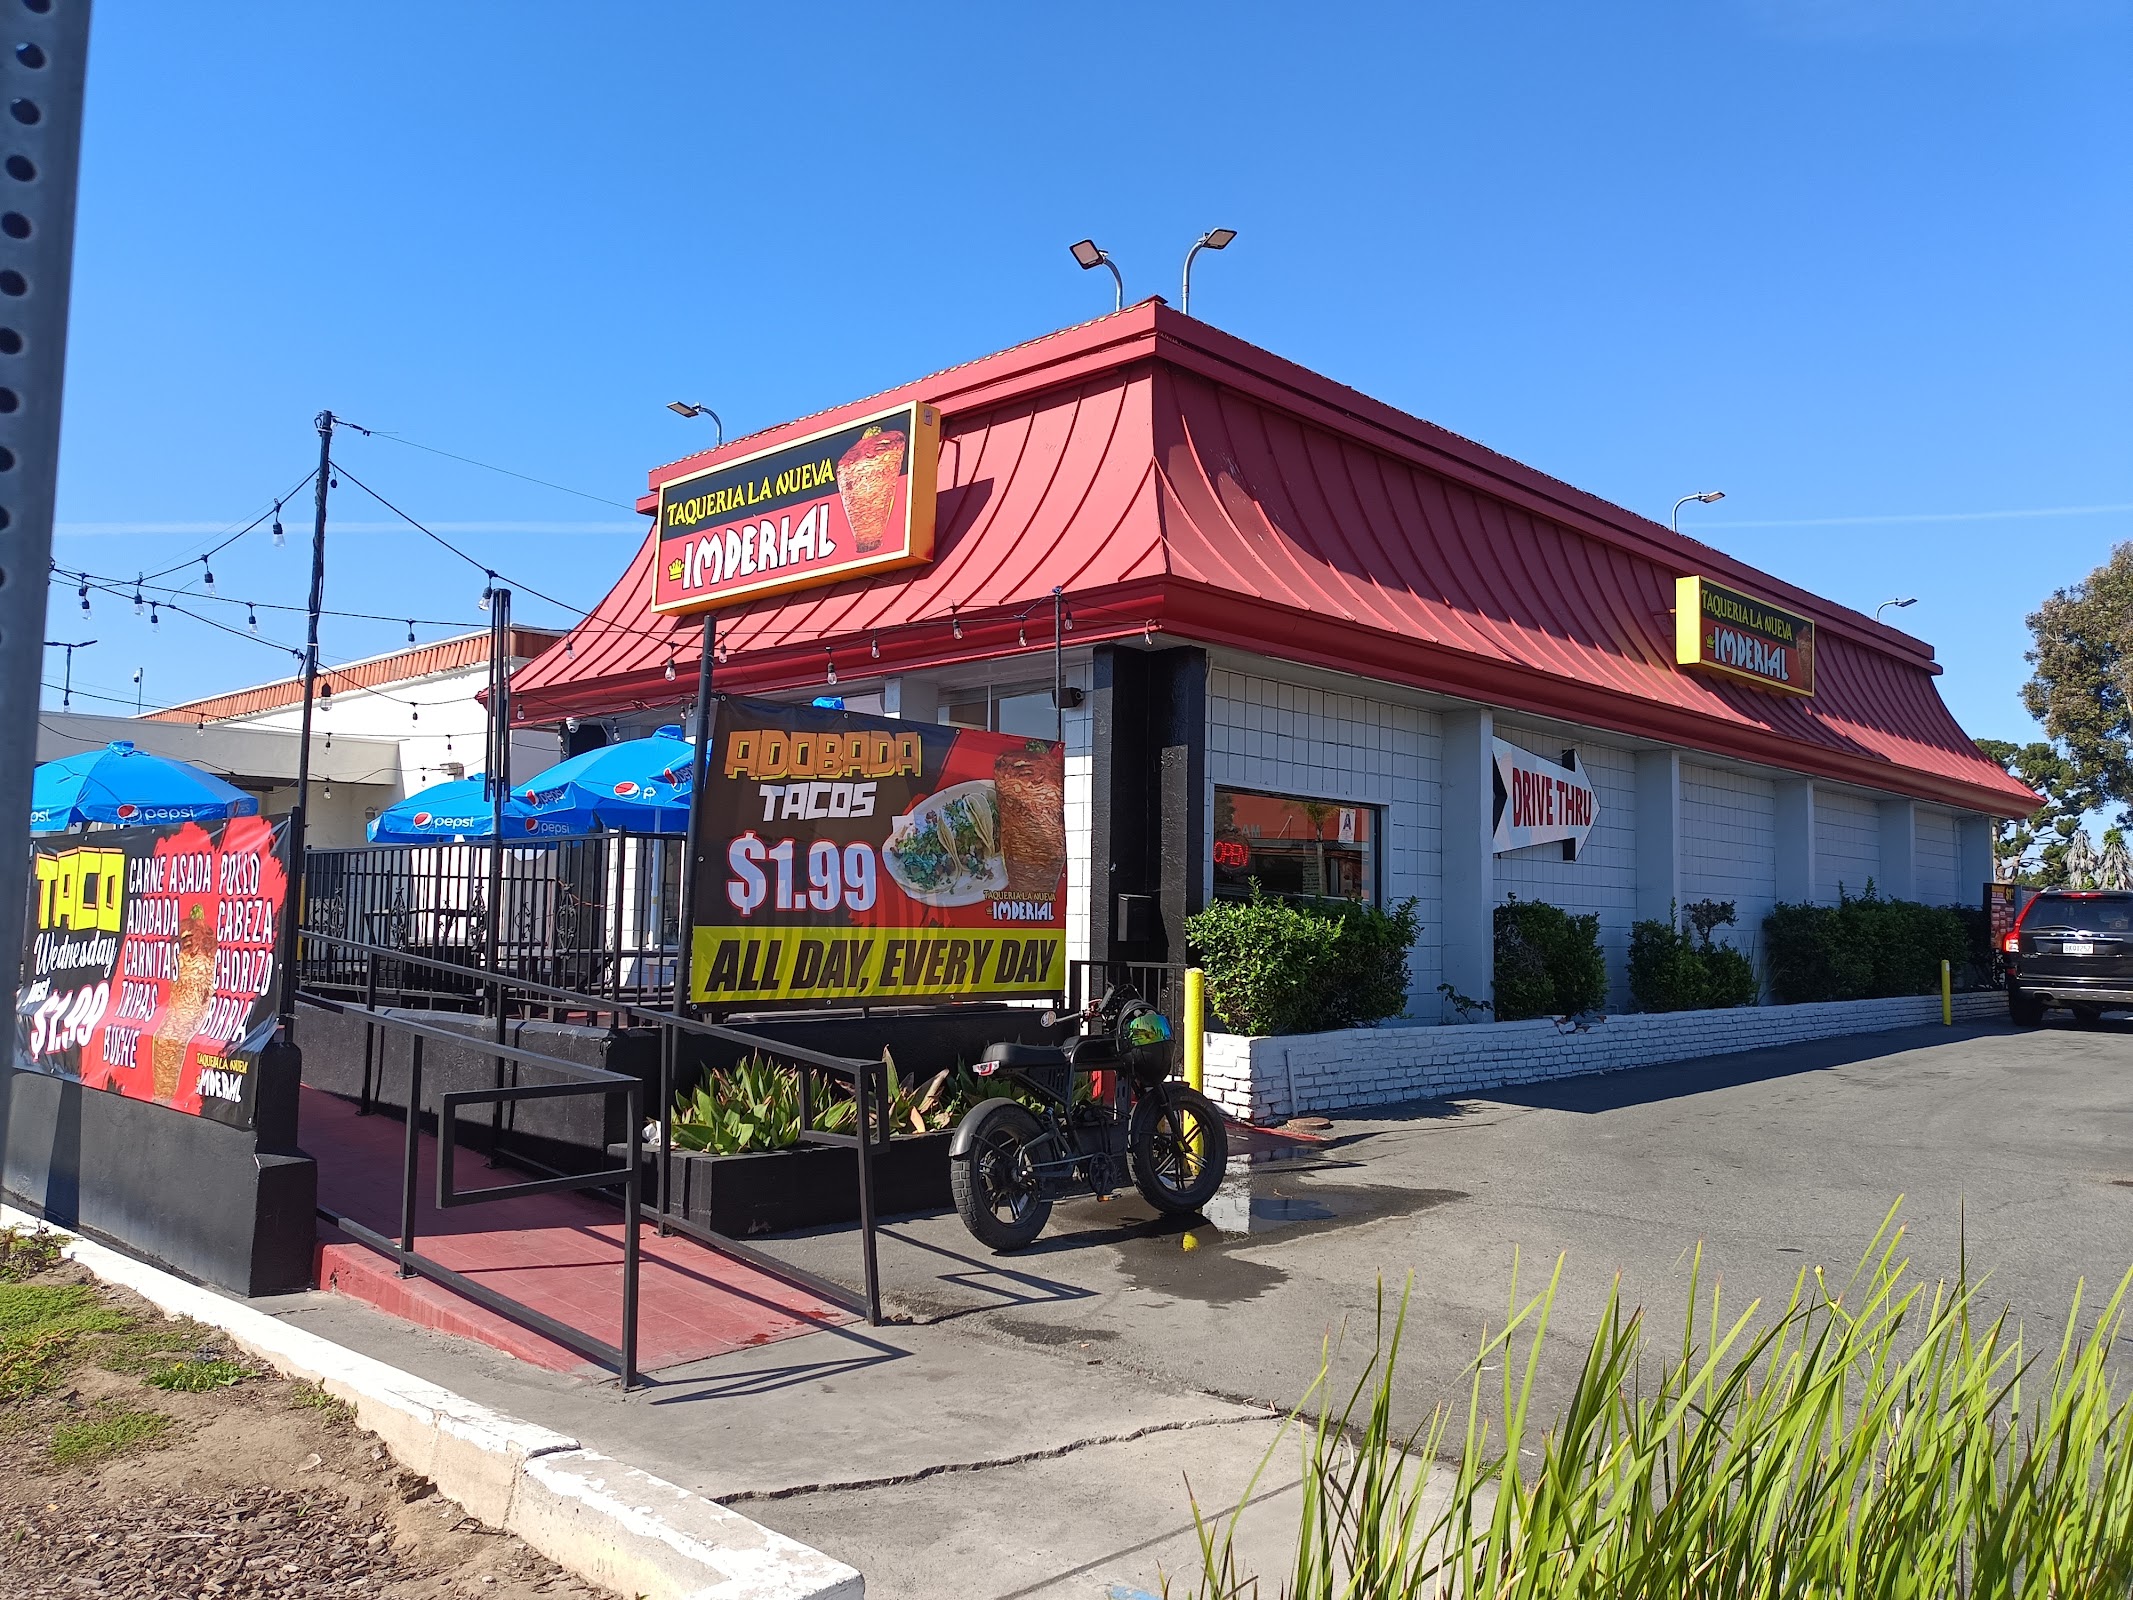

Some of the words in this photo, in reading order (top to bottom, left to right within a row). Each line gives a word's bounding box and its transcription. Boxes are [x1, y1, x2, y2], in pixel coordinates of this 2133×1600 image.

[667, 484, 745, 526] TAQUERIA
[748, 476, 772, 505] LA
[775, 458, 836, 497] NUEVA
[1701, 589, 1749, 625] TAQUERIA
[1750, 609, 1763, 630] LA
[1764, 615, 1793, 641] NUEVA
[724, 729, 923, 780] ADOBADA
[30, 808, 51, 823] psi
[145, 806, 195, 821] pepsi
[759, 781, 878, 822] TACOS
[1512, 766, 1554, 828] DRIVE
[1556, 779, 1592, 826] THRU
[434, 815, 474, 829] pepsi
[541, 822, 570, 834] pepsi
[128, 855, 165, 894] CARNE
[168, 852, 212, 894] ASADA
[218, 852, 261, 896] POLLO
[726, 830, 877, 917] $1.99
[1213, 841, 1249, 867] OPEN
[36, 846, 126, 932] TACO
[983, 890, 1021, 901] TAQUERIA
[1022, 892, 1033, 900] LA
[1033, 892, 1057, 901] NUEVA
[125, 898, 180, 937] ADOBADA
[216, 898, 273, 945] CABEZA
[33, 930, 118, 979] Wednesday
[123, 940, 181, 981] CARNITAS
[212, 947, 275, 997] CHORIZO
[704, 940, 786, 993] ALL
[790, 938, 874, 993] DAY,
[878, 938, 994, 988] EVERY
[993, 938, 1058, 984] DAY
[30, 981, 110, 1062] $1.99
[114, 980, 159, 1023] TRIPAS
[200, 996, 255, 1044] BIRRIA
[102, 1024, 141, 1069] BUCHE
